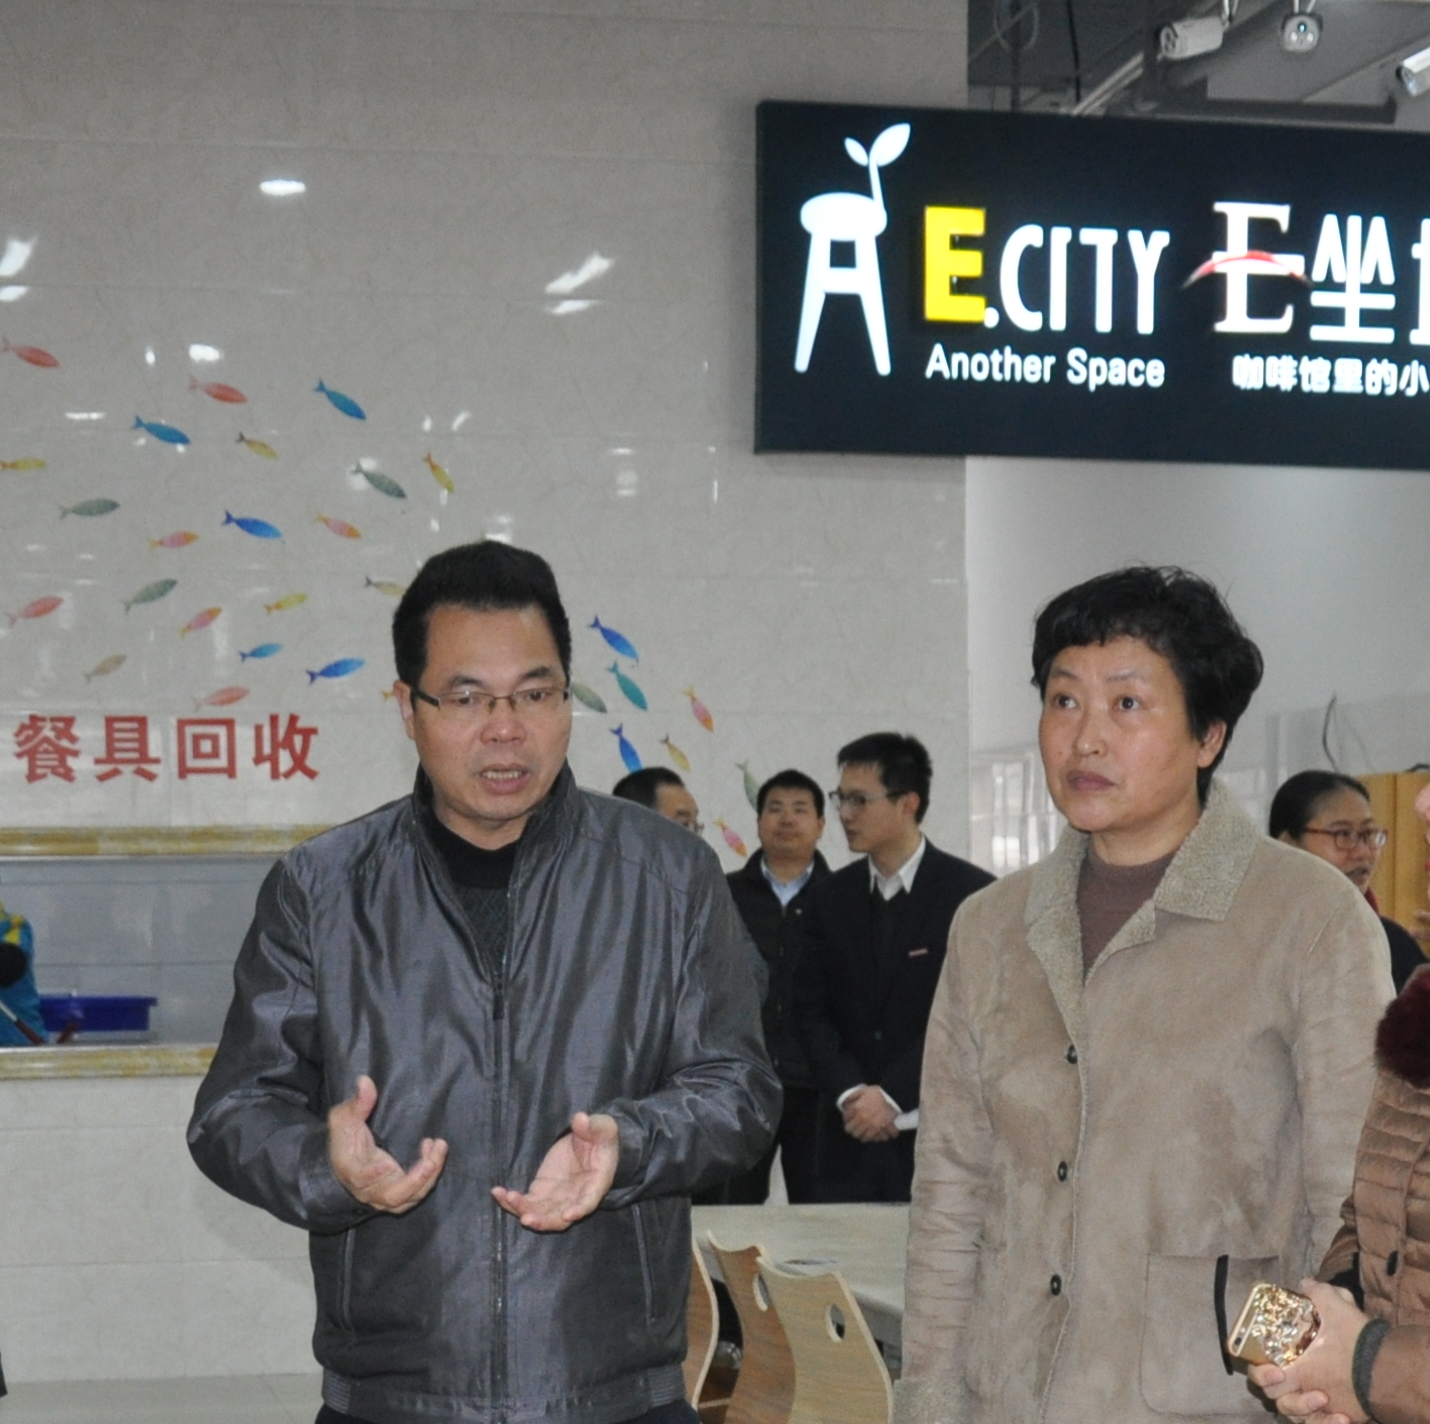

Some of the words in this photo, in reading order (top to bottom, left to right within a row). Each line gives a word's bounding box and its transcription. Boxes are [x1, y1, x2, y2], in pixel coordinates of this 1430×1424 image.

[924, 206, 1171, 335] E.CITY
[925, 342, 1056, 384] Another
[1066, 347, 1167, 391] Space
[13, 712, 320, 784] 餐具回收
